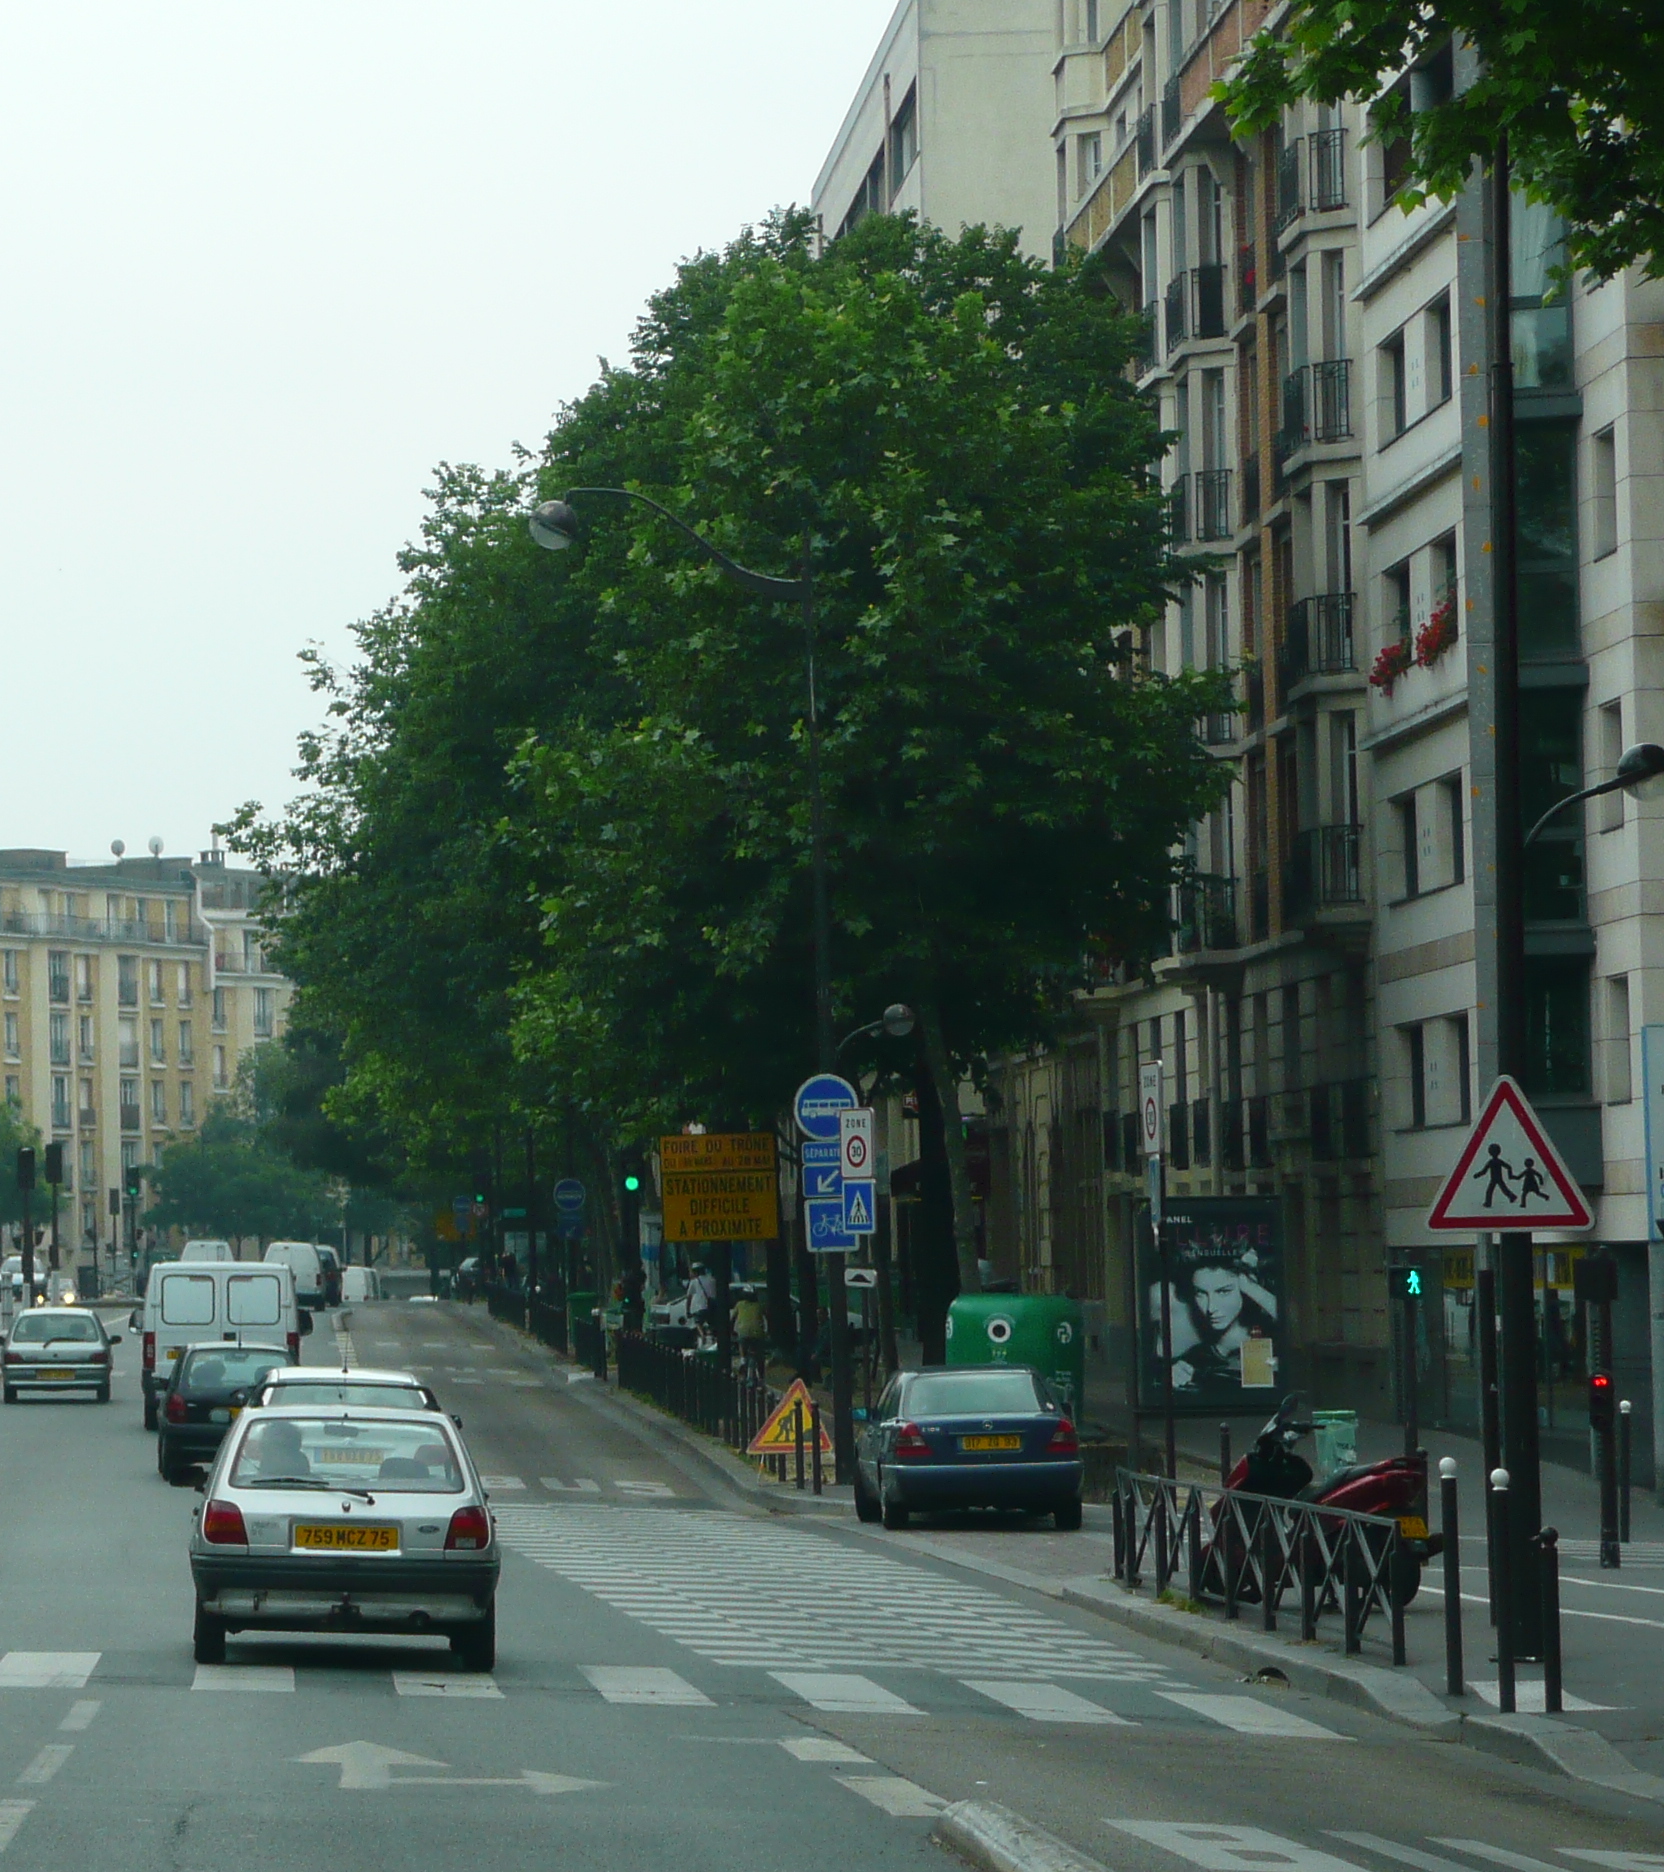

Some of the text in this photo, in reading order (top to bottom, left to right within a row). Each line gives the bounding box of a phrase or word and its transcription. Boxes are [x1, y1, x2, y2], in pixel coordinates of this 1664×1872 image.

[845, 1118, 866, 1129] ZONE
[663, 1134, 769, 1155] FOIRE DU TRÔNE
[851, 1146, 862, 1157] 30
[666, 1175, 772, 1195] STATIONNEMENT
[690, 1198, 750, 1216] DIFFICILE
[679, 1218, 762, 1237] A PROXIMITE
[1164, 1215, 1193, 1224] ANEL
[303, 1529, 389, 1546] 759 MCZ 75
